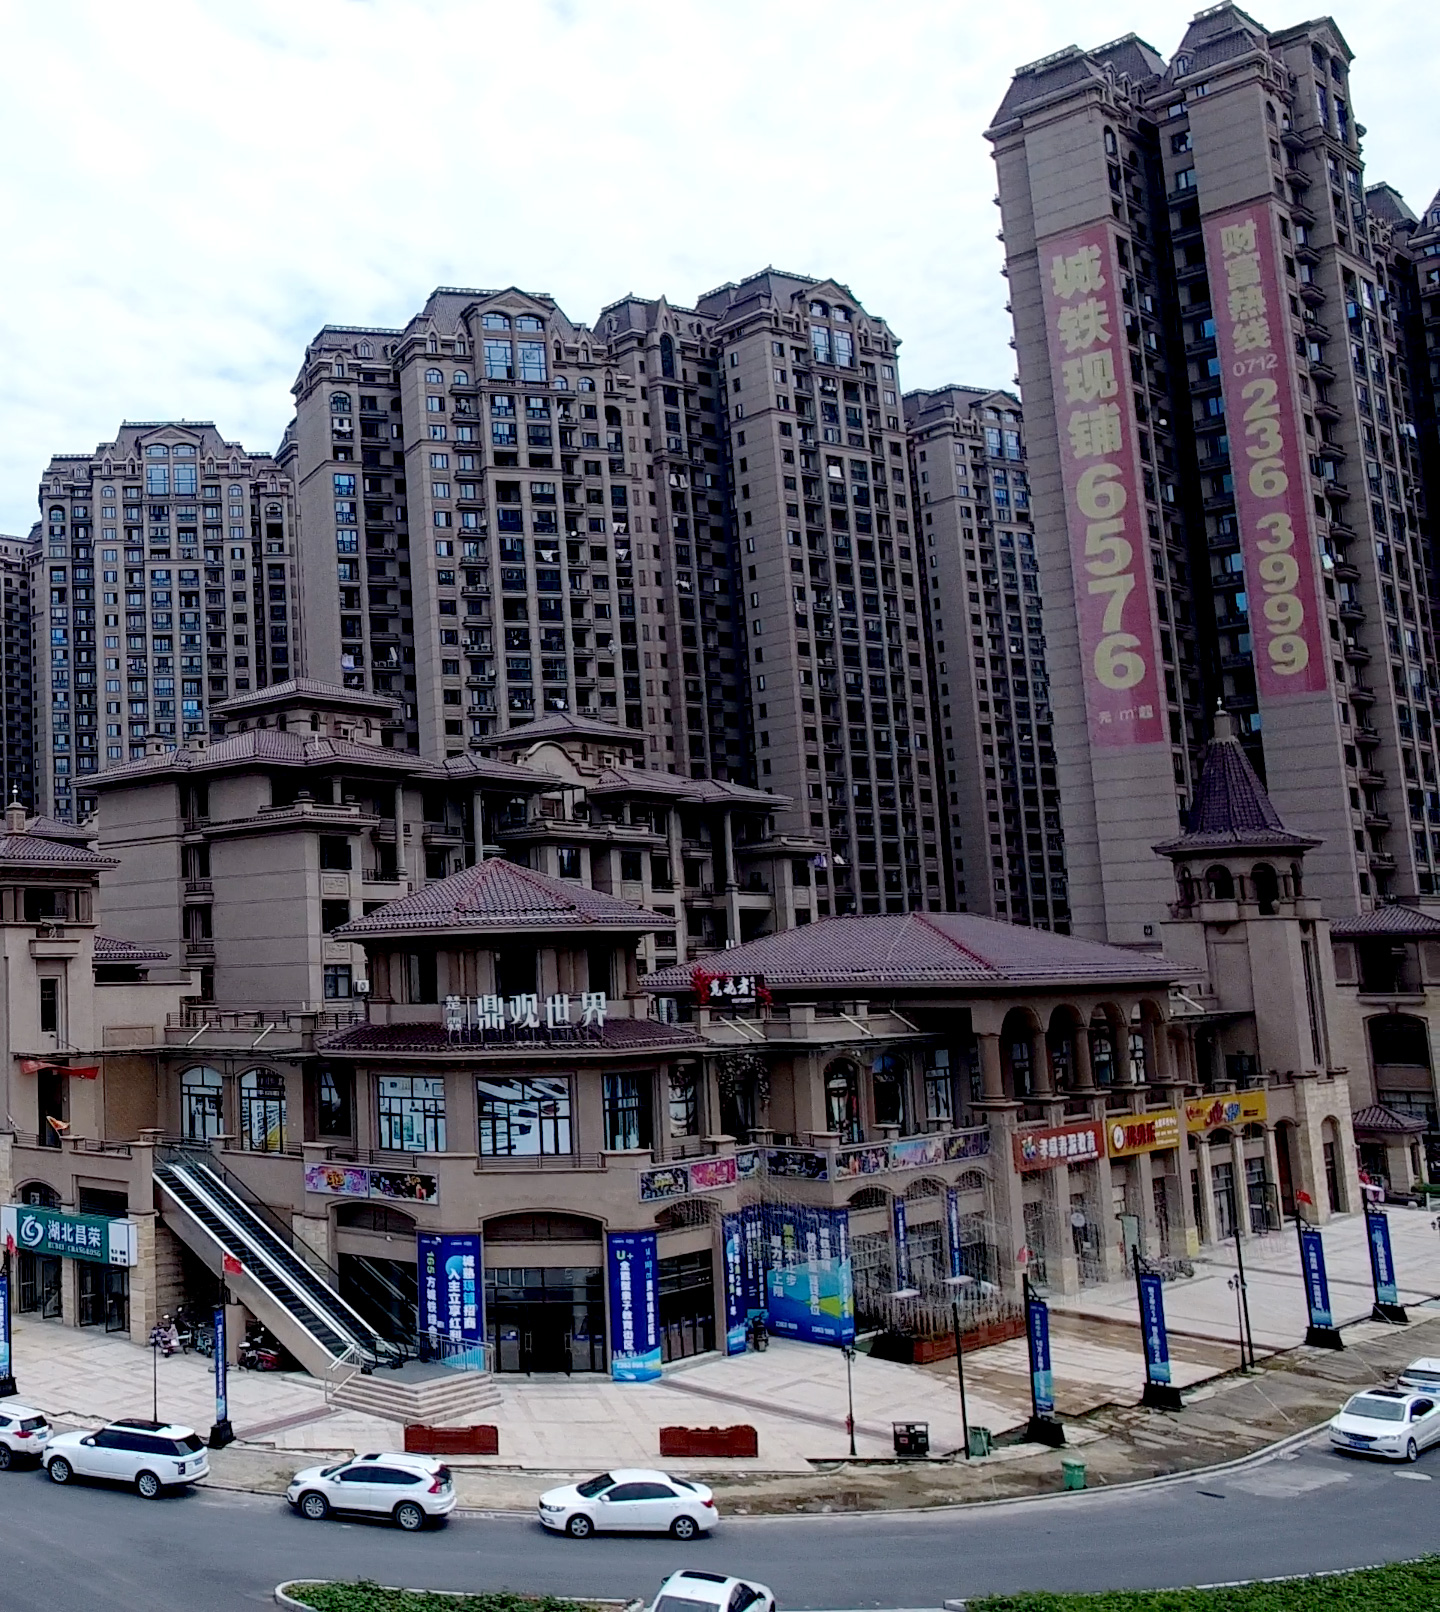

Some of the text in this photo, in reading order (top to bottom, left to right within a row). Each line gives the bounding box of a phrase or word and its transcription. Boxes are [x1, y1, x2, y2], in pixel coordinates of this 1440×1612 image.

[1220, 219, 1271, 354] 财富热线
[1232, 353, 1279, 377] 0712
[477, 991, 608, 1031] 鼎观世界
[47, 1219, 102, 1248] 湖北昌荣
